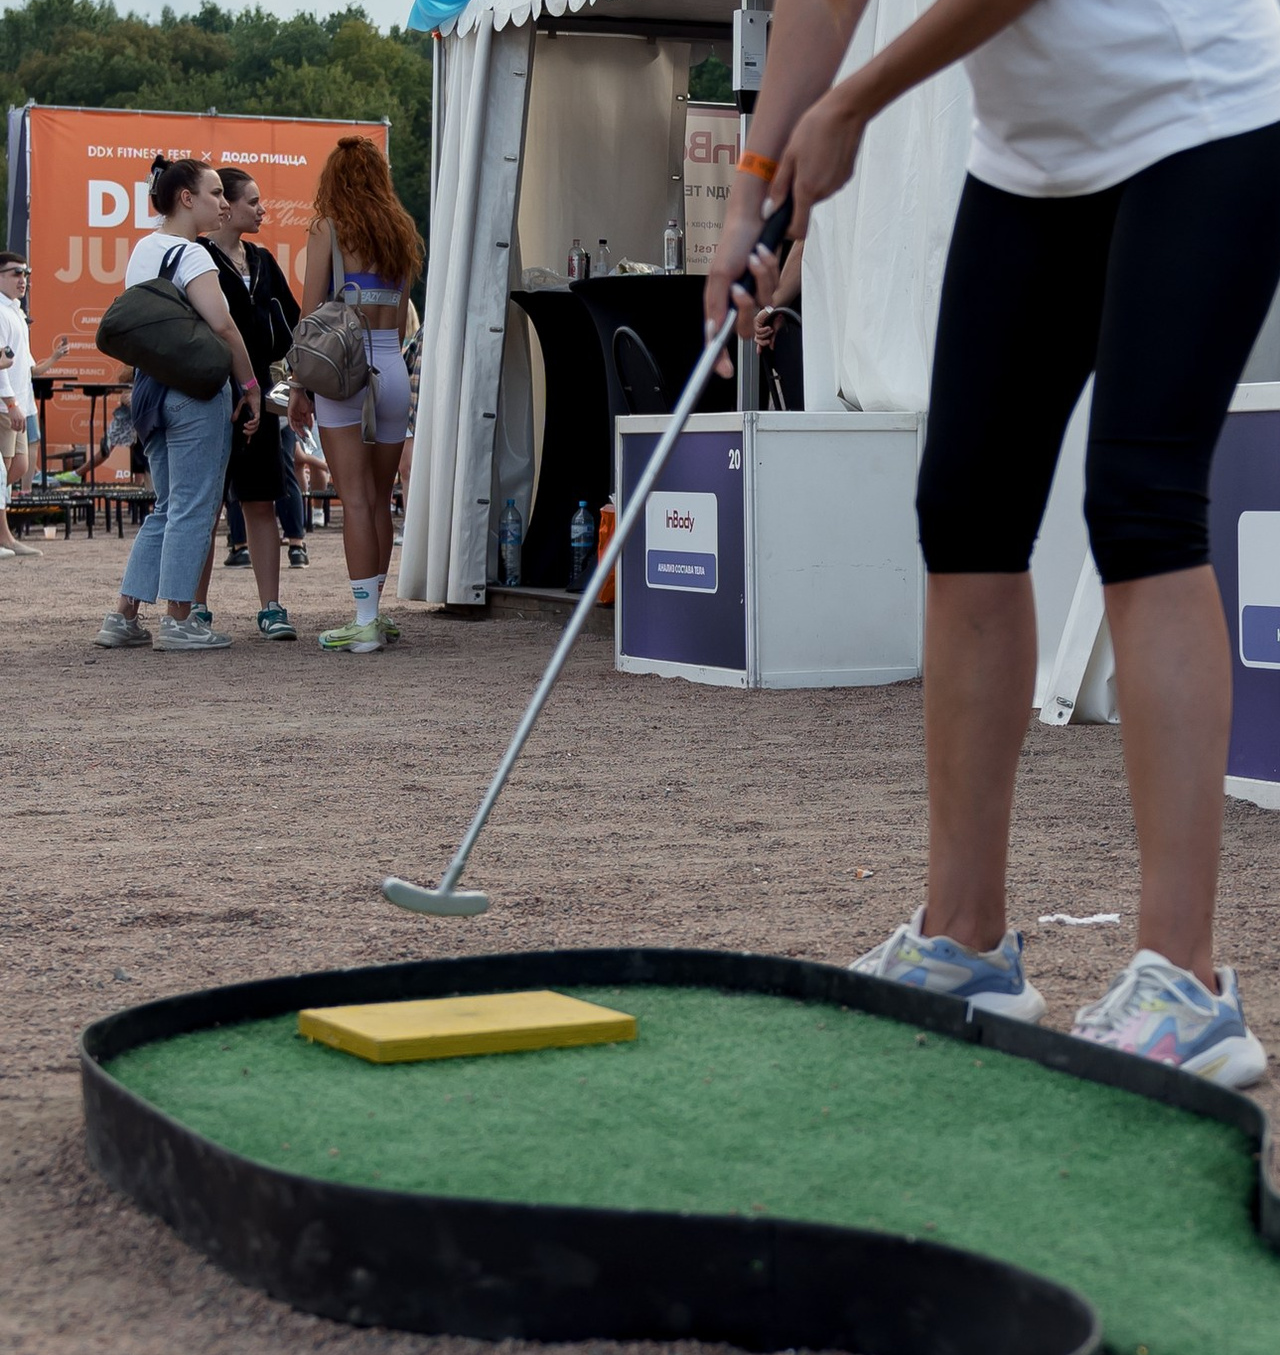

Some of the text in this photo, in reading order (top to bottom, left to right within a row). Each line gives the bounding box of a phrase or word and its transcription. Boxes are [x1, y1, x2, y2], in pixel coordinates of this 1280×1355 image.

[88, 145, 113, 158] DDX
[168, 149, 192, 160] FEST
[221, 151, 307, 166] ДОДО ПИЦЦА
[728, 449, 741, 470] 20
[666, 509, 695, 533] InBody
[658, 563, 705, 576] АНАЛИЗ СОСТАВА ТЕЛА
